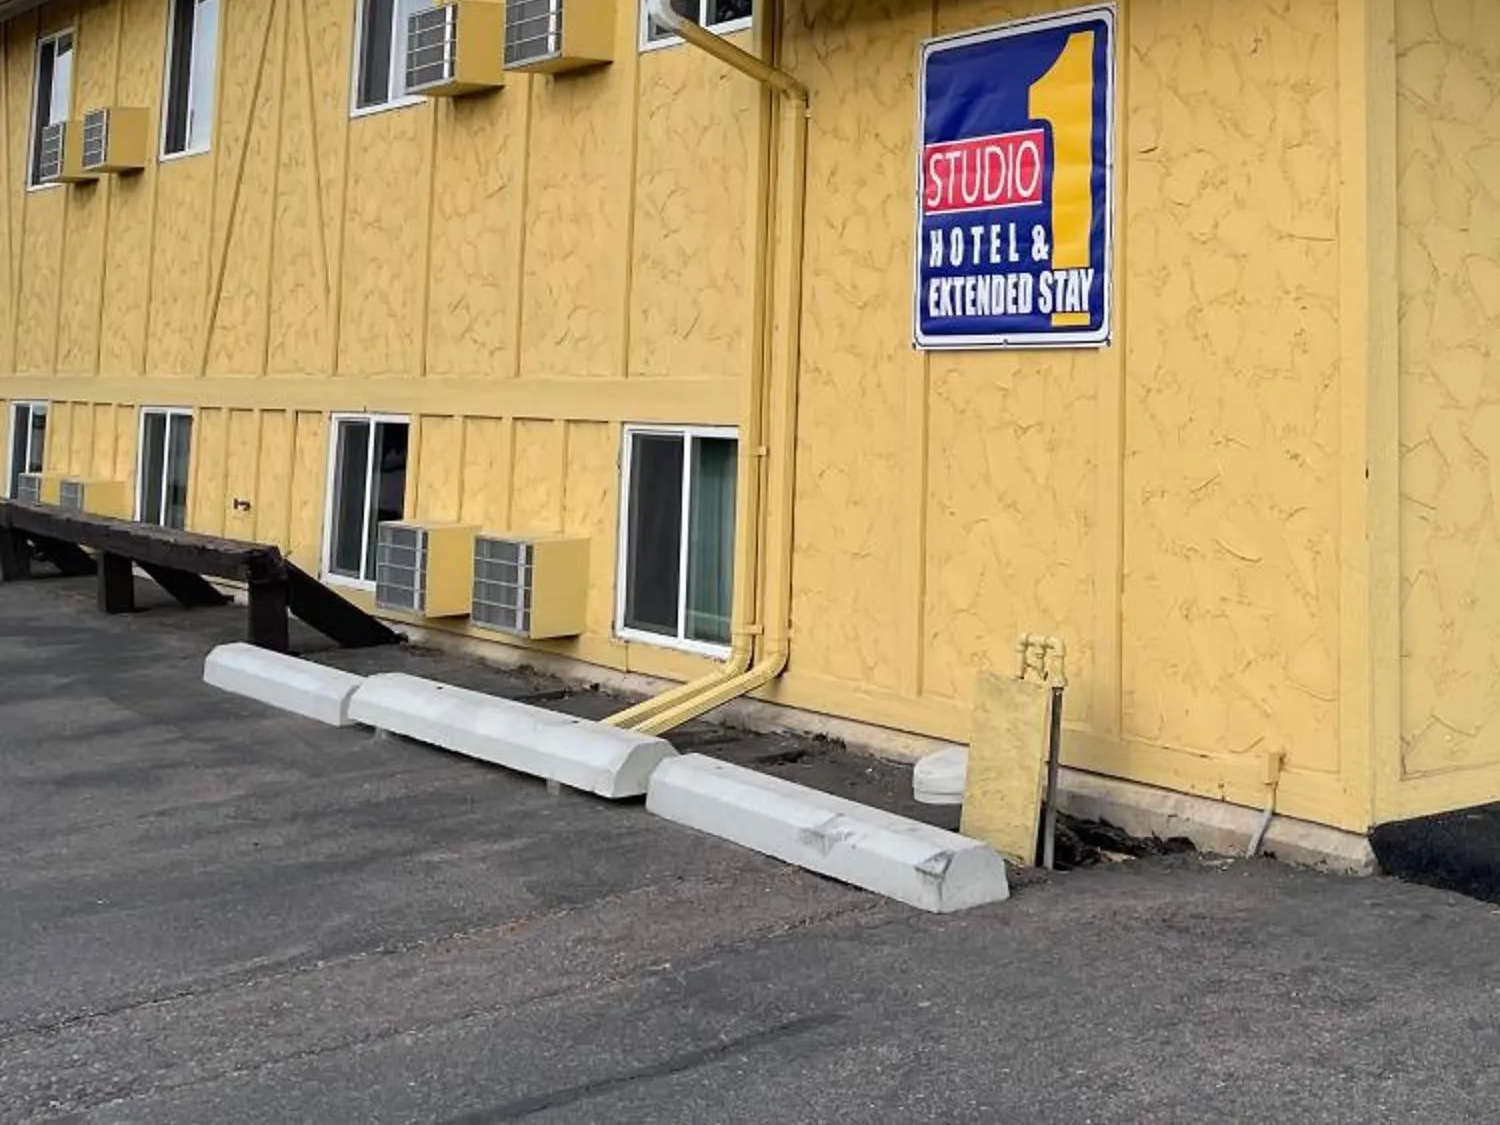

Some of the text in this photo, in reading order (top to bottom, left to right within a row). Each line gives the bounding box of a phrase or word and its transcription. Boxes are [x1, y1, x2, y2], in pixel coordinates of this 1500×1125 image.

[925, 139, 1041, 208] STUDIO
[1028, 30, 1095, 326] 1
[929, 222, 1050, 268] HOTEL &
[928, 267, 1095, 318] EXTENDED STAY
